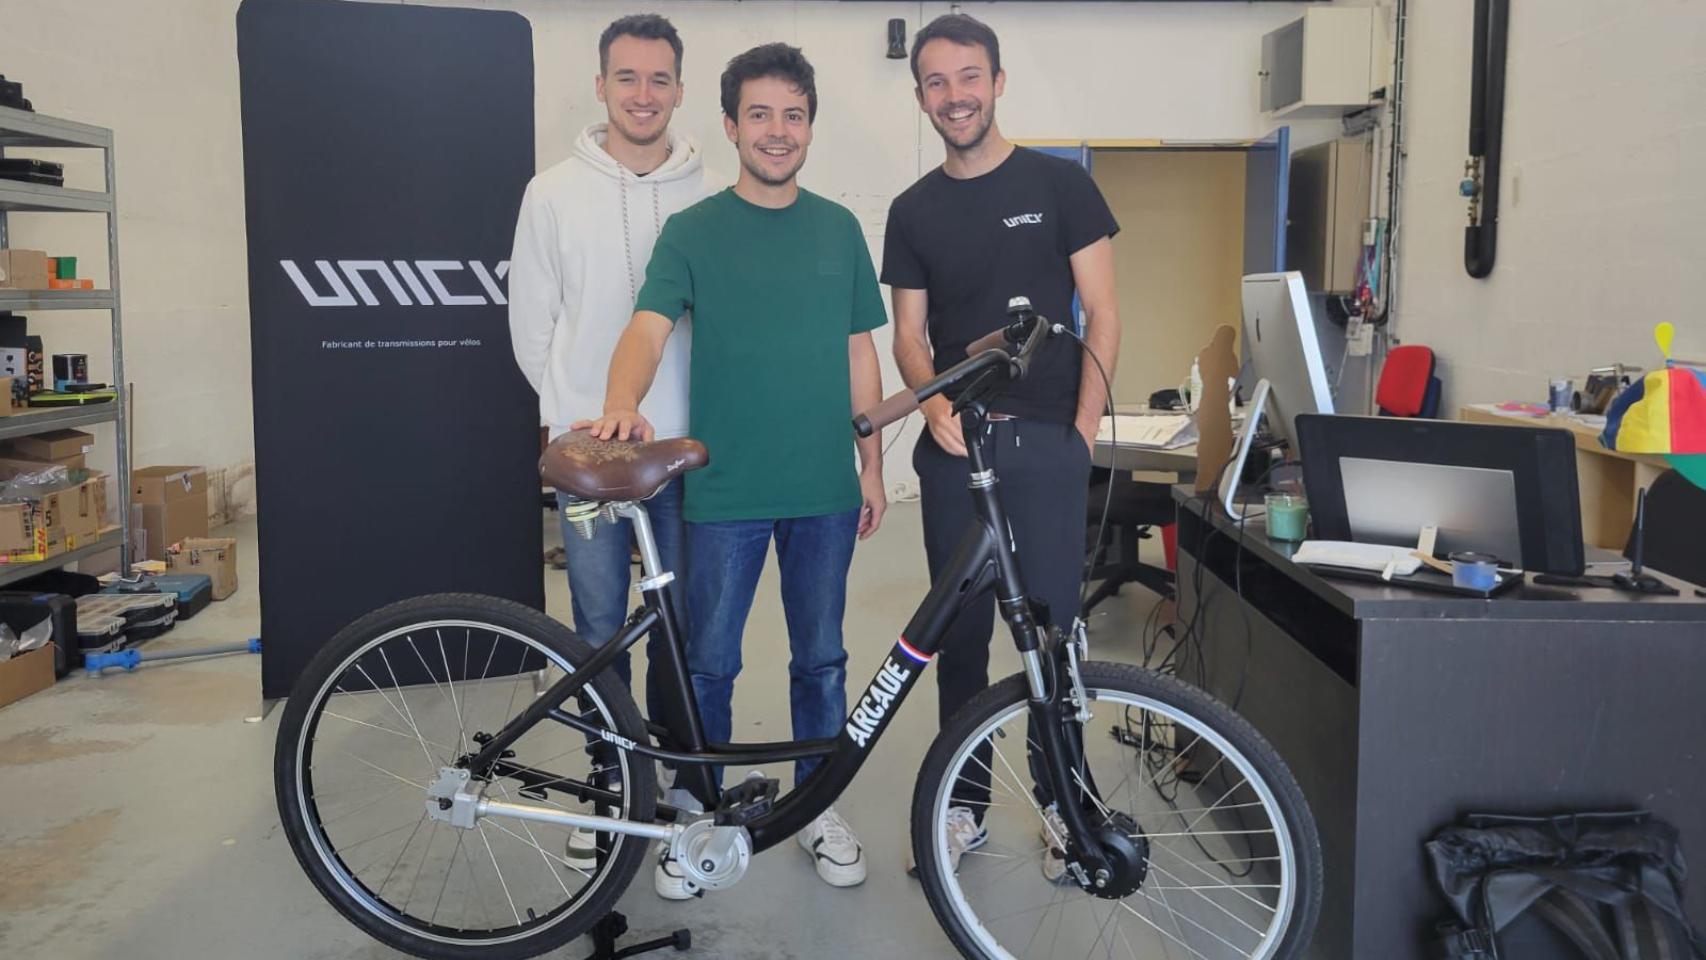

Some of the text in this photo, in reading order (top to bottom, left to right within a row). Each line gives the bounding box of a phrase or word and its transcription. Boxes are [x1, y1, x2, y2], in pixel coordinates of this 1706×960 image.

[321, 338, 481, 349] Fabricant de transmissions pour vélos
[846, 656, 911, 747] ARCADE
